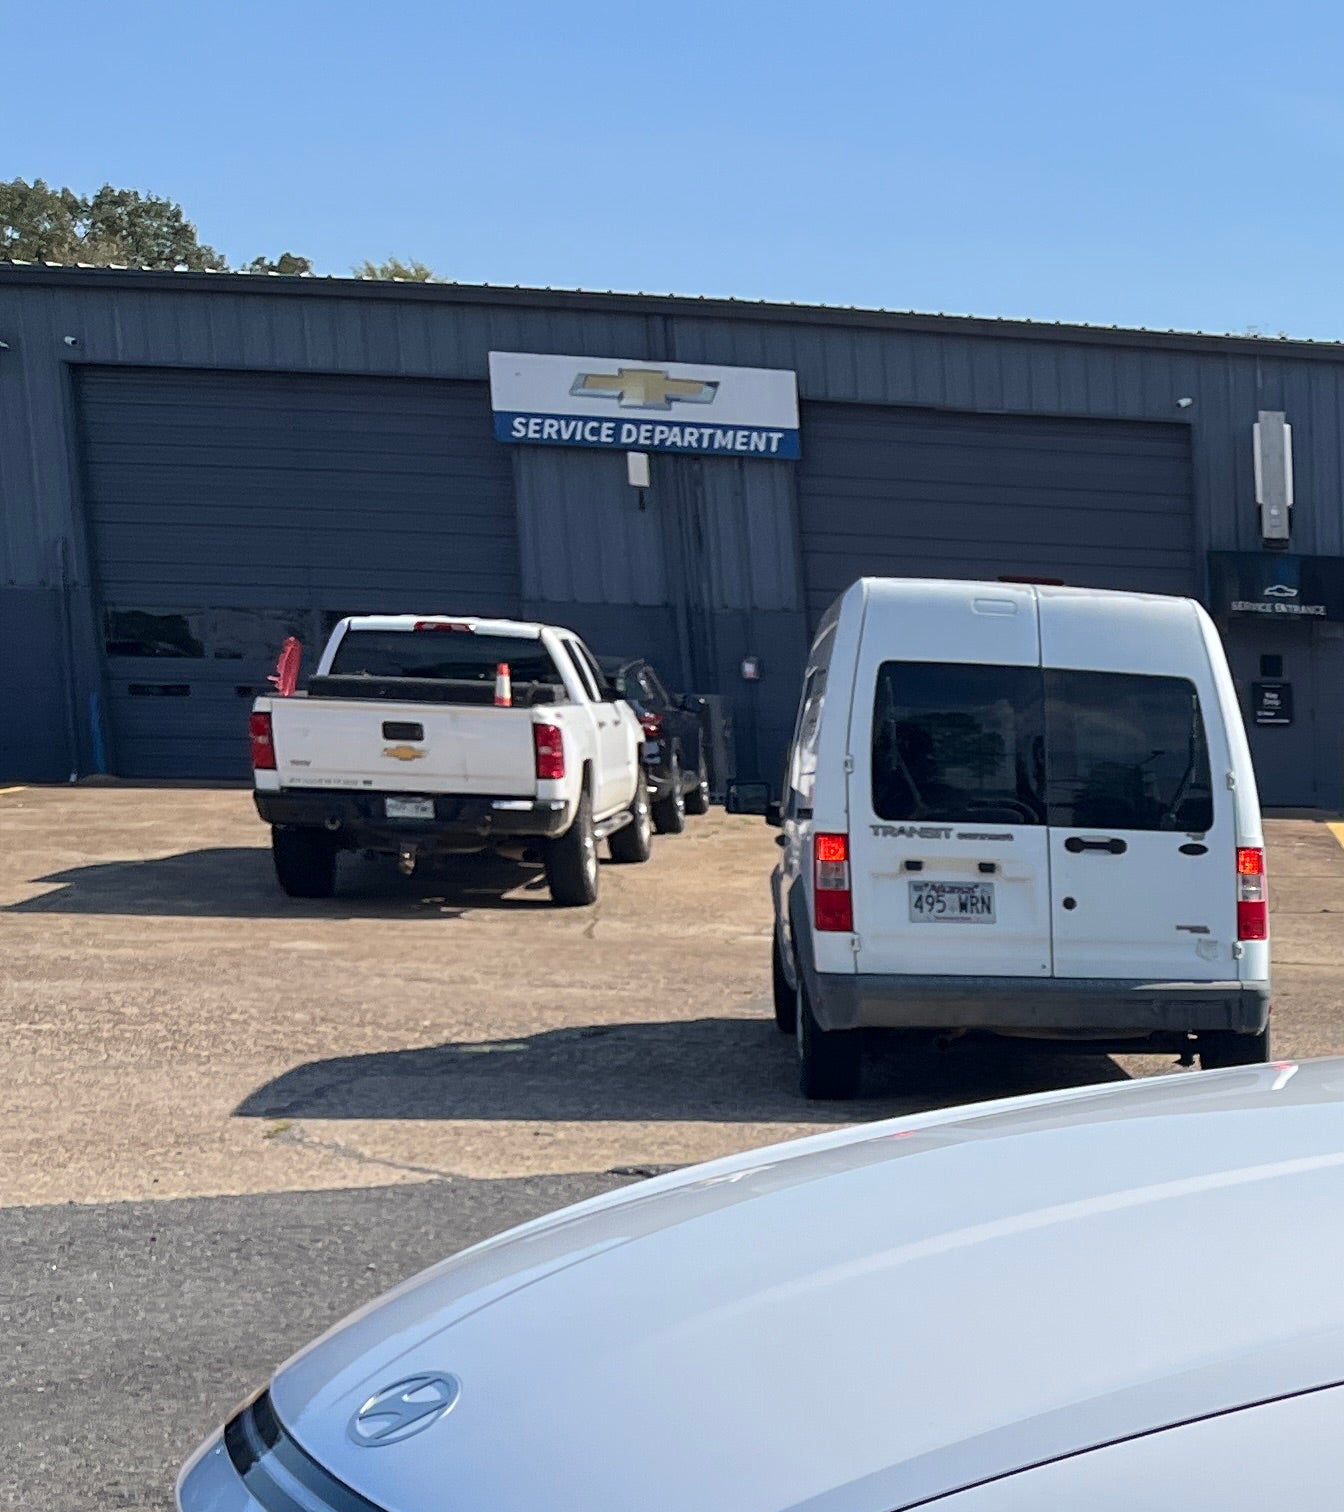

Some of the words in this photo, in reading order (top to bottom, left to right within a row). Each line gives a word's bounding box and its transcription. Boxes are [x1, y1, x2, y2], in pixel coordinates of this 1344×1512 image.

[511, 416, 614, 444] SERVICE
[619, 422, 785, 454] DEPARTMENT
[1231, 600, 1273, 613] SERVICE
[869, 825, 953, 840] TRANSIT
[913, 894, 947, 914] 495
[958, 895, 992, 915] WRN
